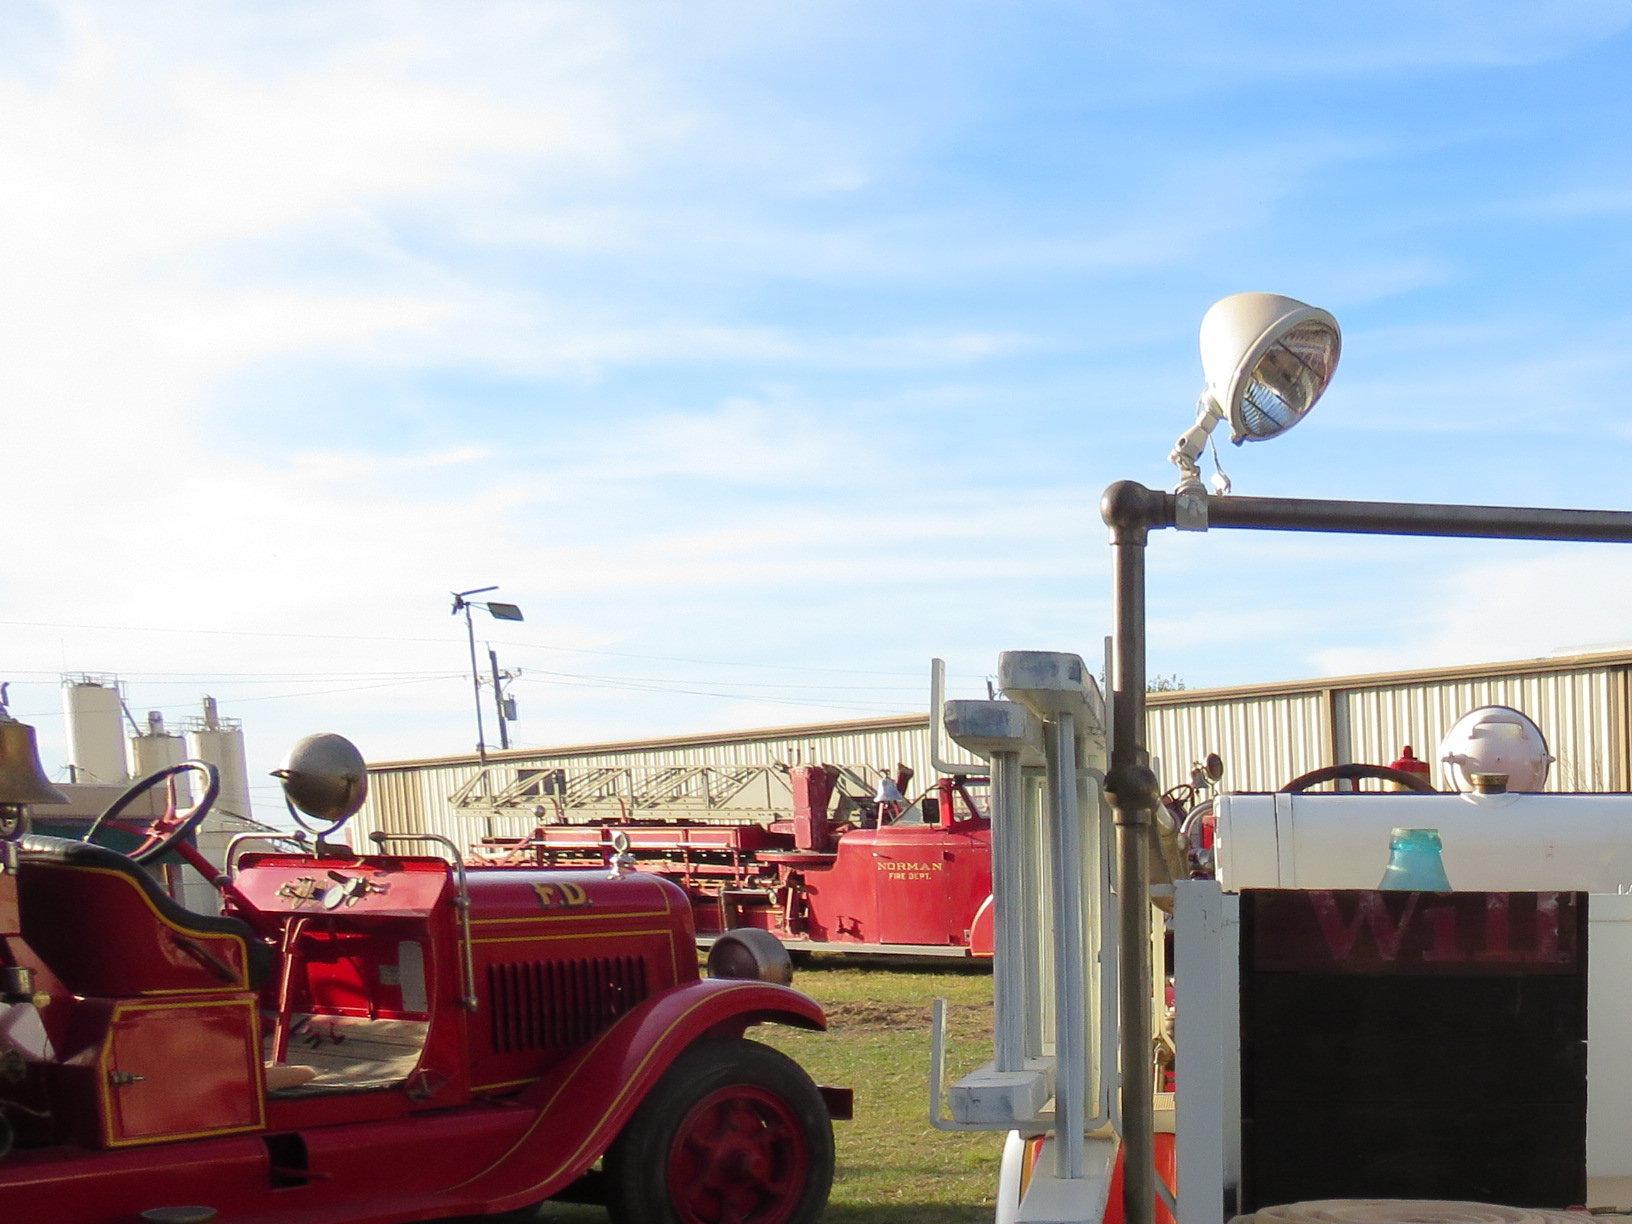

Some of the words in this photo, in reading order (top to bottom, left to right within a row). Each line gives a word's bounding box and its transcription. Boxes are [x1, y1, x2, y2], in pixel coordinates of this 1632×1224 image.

[877, 861, 943, 871] NORMAN
[888, 872, 906, 880] FIRE
[908, 872, 932, 880] DEPT.
